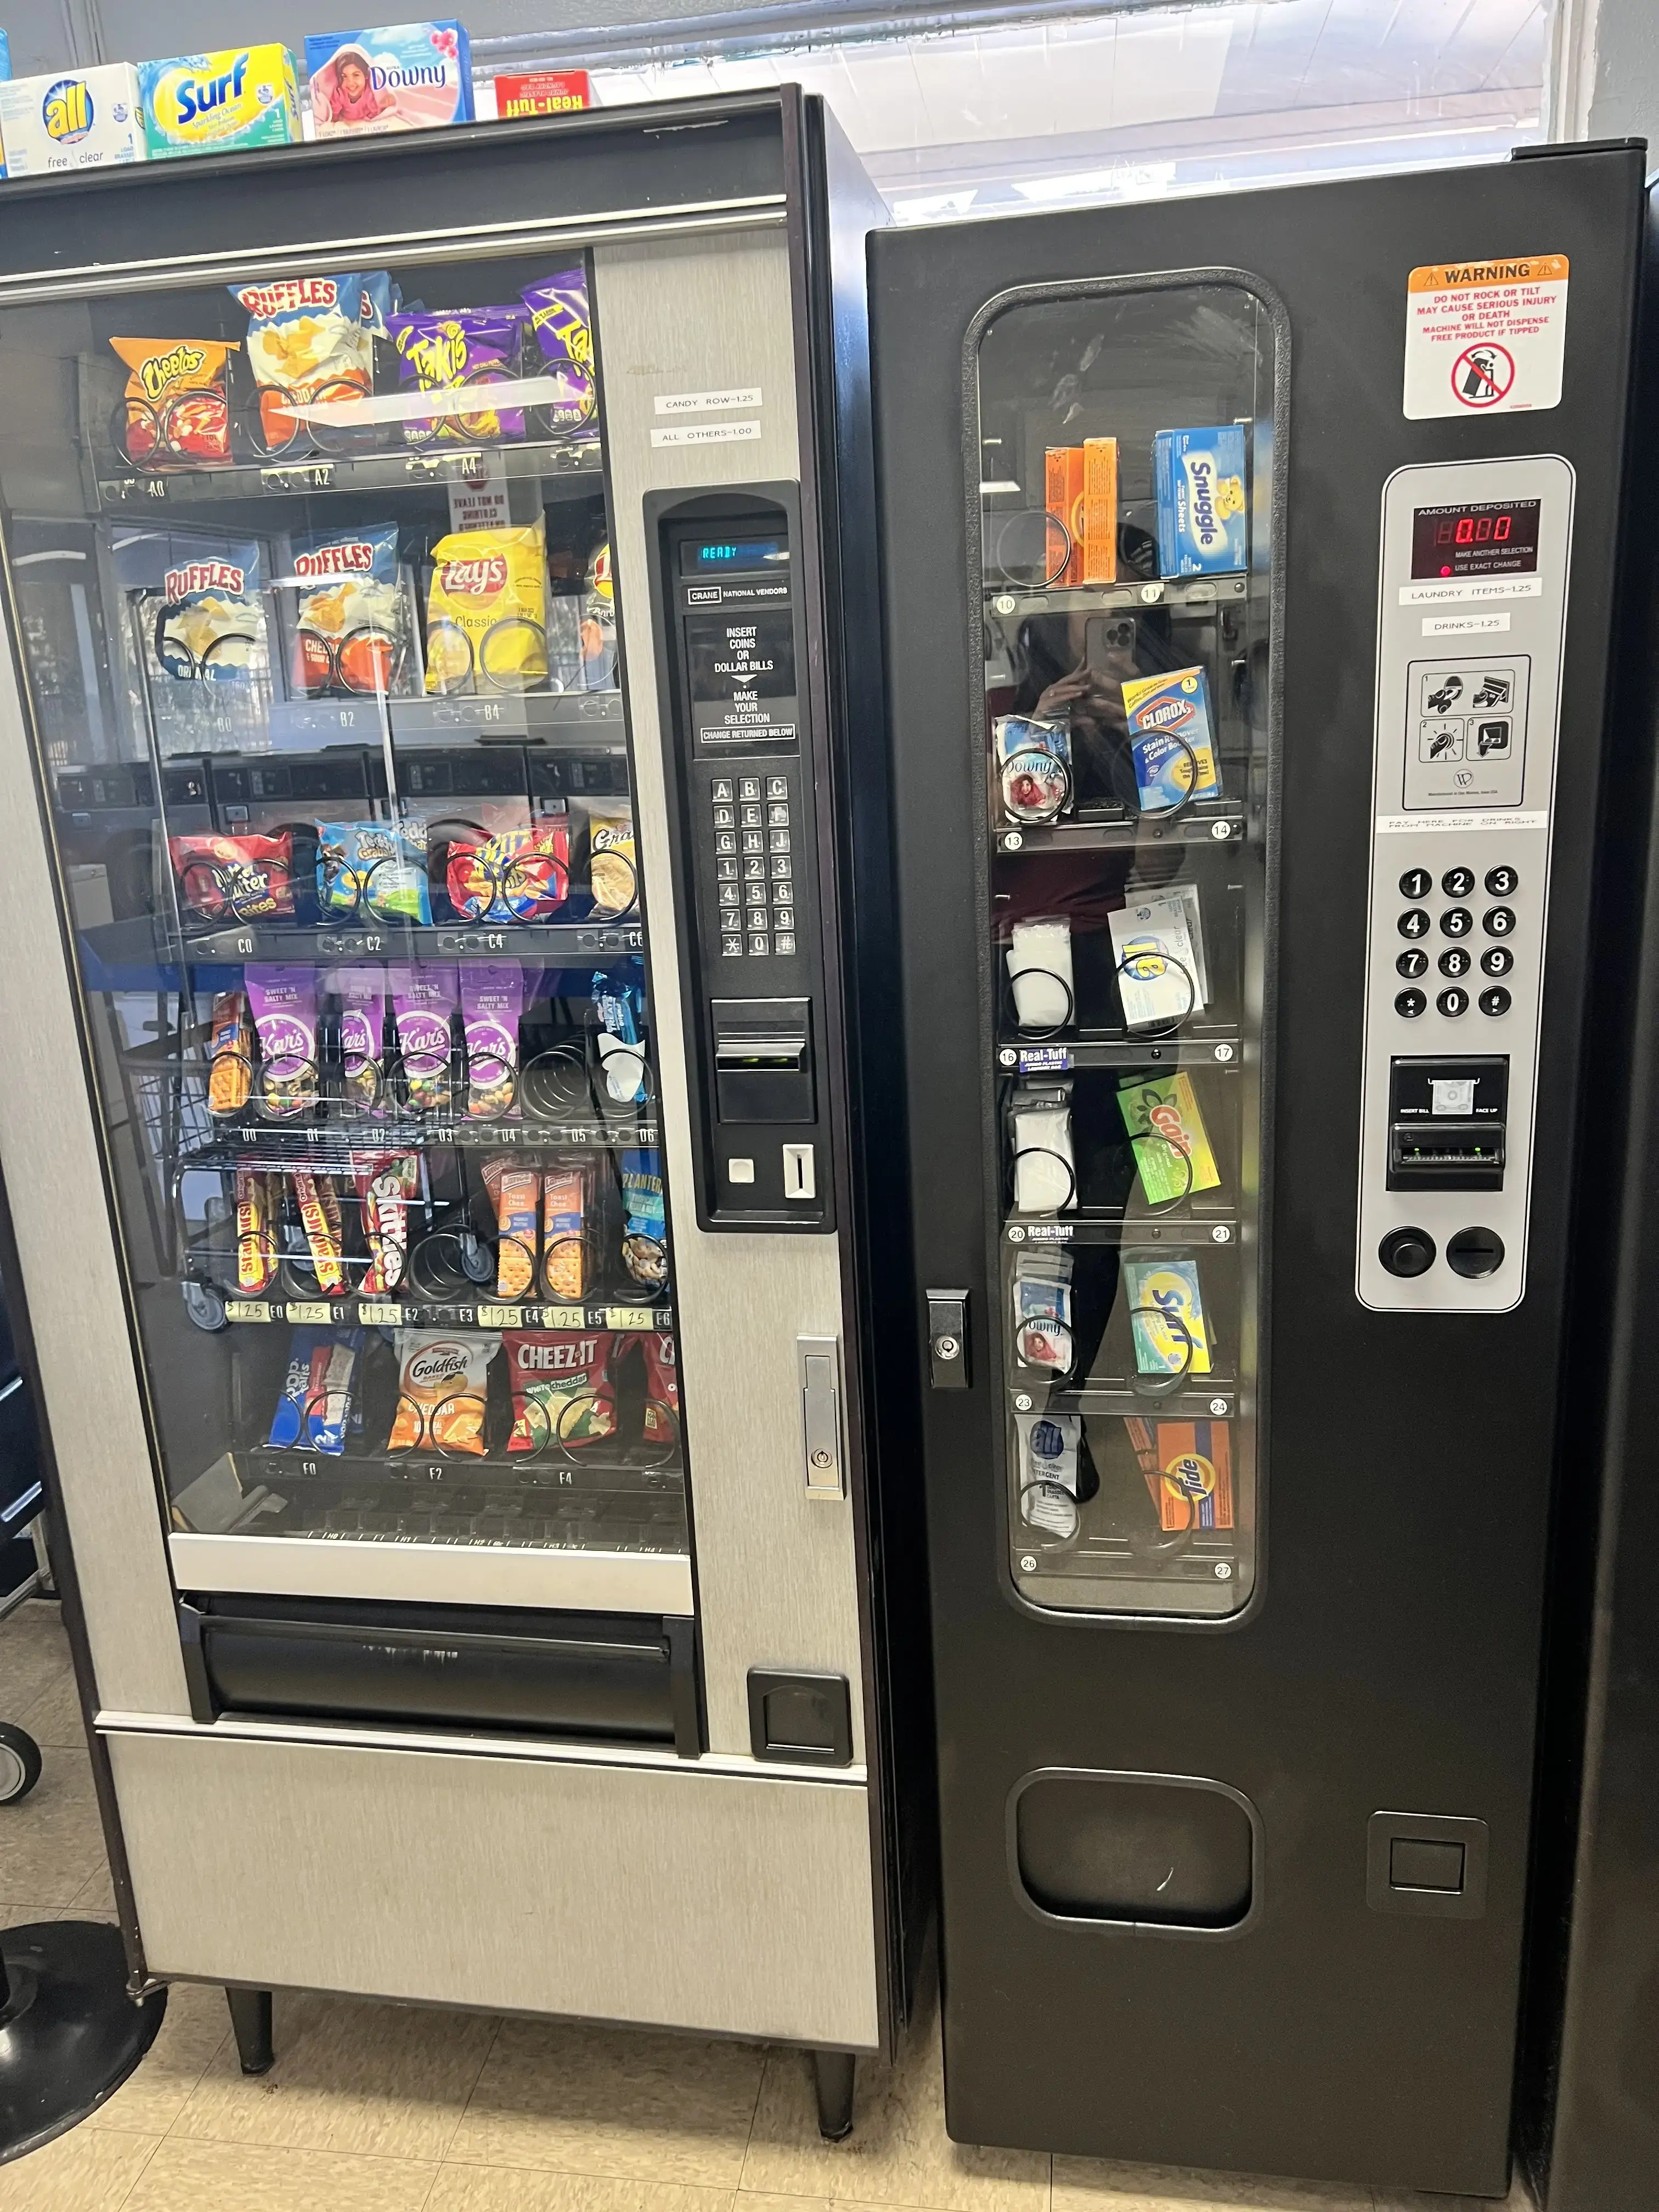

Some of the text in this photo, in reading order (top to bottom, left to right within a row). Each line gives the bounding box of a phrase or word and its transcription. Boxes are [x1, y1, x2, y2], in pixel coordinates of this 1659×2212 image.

[370, 65, 447, 90] Downy
[176, 53, 249, 125] Surf
[46, 81, 87, 138] all
[506, 95, 583, 117] Real-Tuff
[48, 151, 104, 168] free clear
[1444, 263, 1530, 284] WARNING
[242, 279, 336, 318] RUFFLES
[1434, 296, 1447, 304] DO
[1451, 293, 1471, 302] NOT
[1474, 291, 1500, 300] ROCK
[1521, 287, 1541, 296] TILT
[1417, 296, 1557, 315] MAY CAUSE SERIOUS INJURY
[1462, 310, 1510, 321] OR DEATH
[1423, 324, 1462, 334] MACHINE
[1487, 320, 1504, 328] NOT
[1506, 316, 1549, 327] DISPENSE
[1431, 326, 1539, 342] FREE PRODUCT IF TIPPED
[141, 346, 205, 399] Cheetos
[666, 394, 754, 409] CANDY ROW-1.25
[687, 428, 752, 439] OTHERS-1.00
[461, 456, 476, 475] A4
[314, 467, 330, 486] A2
[1190, 461, 1218, 545] Snuggle
[1418, 500, 1537, 516] AMOUNT DEPOSITED
[1177, 500, 1187, 533] Sheets
[702, 546, 737, 559] READY
[1472, 548, 1500, 557] ANOTHER
[1500, 546, 1533, 555] SELECTION
[1455, 560, 1522, 571] USE EXACT CHANGE
[442, 552, 505, 596] Lay's
[166, 563, 244, 606] RUFFLES
[691, 586, 788, 601] CRANE NATIONAL VENDORS
[1411, 589, 1463, 600] LAUNDRY
[1434, 619, 1500, 630] DRINKS-1.25
[726, 627, 757, 638] INSERT
[729, 638, 757, 650] COINS
[736, 650, 750, 661] OR
[714, 660, 774, 673] DOLLAR BILLS
[733, 690, 758, 701] MAKE
[484, 704, 501, 720] B4
[734, 702, 758, 713] YOUR
[340, 711, 356, 727] B2
[724, 713, 771, 725] SELECTION
[703, 727, 793, 740] CHANGE RETURNED BELOW
[1142, 736, 1165, 754] Stain
[1148, 746, 1167, 761] Color
[717, 780, 782, 798] A B C
[719, 806, 783, 824] D E F
[1214, 826, 1228, 835] 14
[720, 832, 785, 850] G H J
[1008, 836, 1020, 846] 13
[723, 859, 787, 875] 1 2 3
[1411, 871, 1509, 894] 1 2 3
[724, 884, 788, 900] 4 5 6
[726, 911, 789, 926] 7 8 9
[1406, 911, 1508, 933] 4 5 6
[366, 936, 381, 951] C2
[488, 933, 503, 949] C4
[754, 936, 764, 951] 0
[1174, 926, 1184, 947] clear
[238, 938, 253, 953] C0
[1407, 952, 1505, 973] 7 8 9
[265, 987, 287, 996] SWEET
[1446, 993, 1460, 1012] 0
[259, 1029, 304, 1058] Kar's
[398, 1026, 445, 1056] Kar's
[1002, 1053, 1014, 1062] 16
[1019, 1047, 1068, 1062] Real-Tuff
[1217, 1048, 1230, 1058] 17
[1150, 1104, 1193, 1159] Gain
[371, 1176, 408, 1286] Skittles
[1011, 1230, 1023, 1239] 20
[1028, 1225, 1074, 1237] Real-Tuff
[1215, 1229, 1227, 1239] 21
[270, 1305, 284, 1318] E0
[334, 1308, 344, 1319] E1
[405, 1308, 419, 1321] E2
[460, 1309, 473, 1322] E3
[526, 1310, 539, 1323] E4
[588, 1311, 602, 1324] E5
[656, 1312, 670, 1326] E6
[1153, 1289, 1204, 1349] Surf
[517, 1339, 598, 1369] CHEEZ-IT
[412, 1356, 468, 1378] Goldfish
[550, 1373, 588, 1391] cheddar
[1018, 1398, 1030, 1407] 23
[1212, 1402, 1226, 1411] 24
[303, 1462, 317, 1475] F0
[429, 1467, 443, 1480] F2
[559, 1471, 573, 1485] F4
